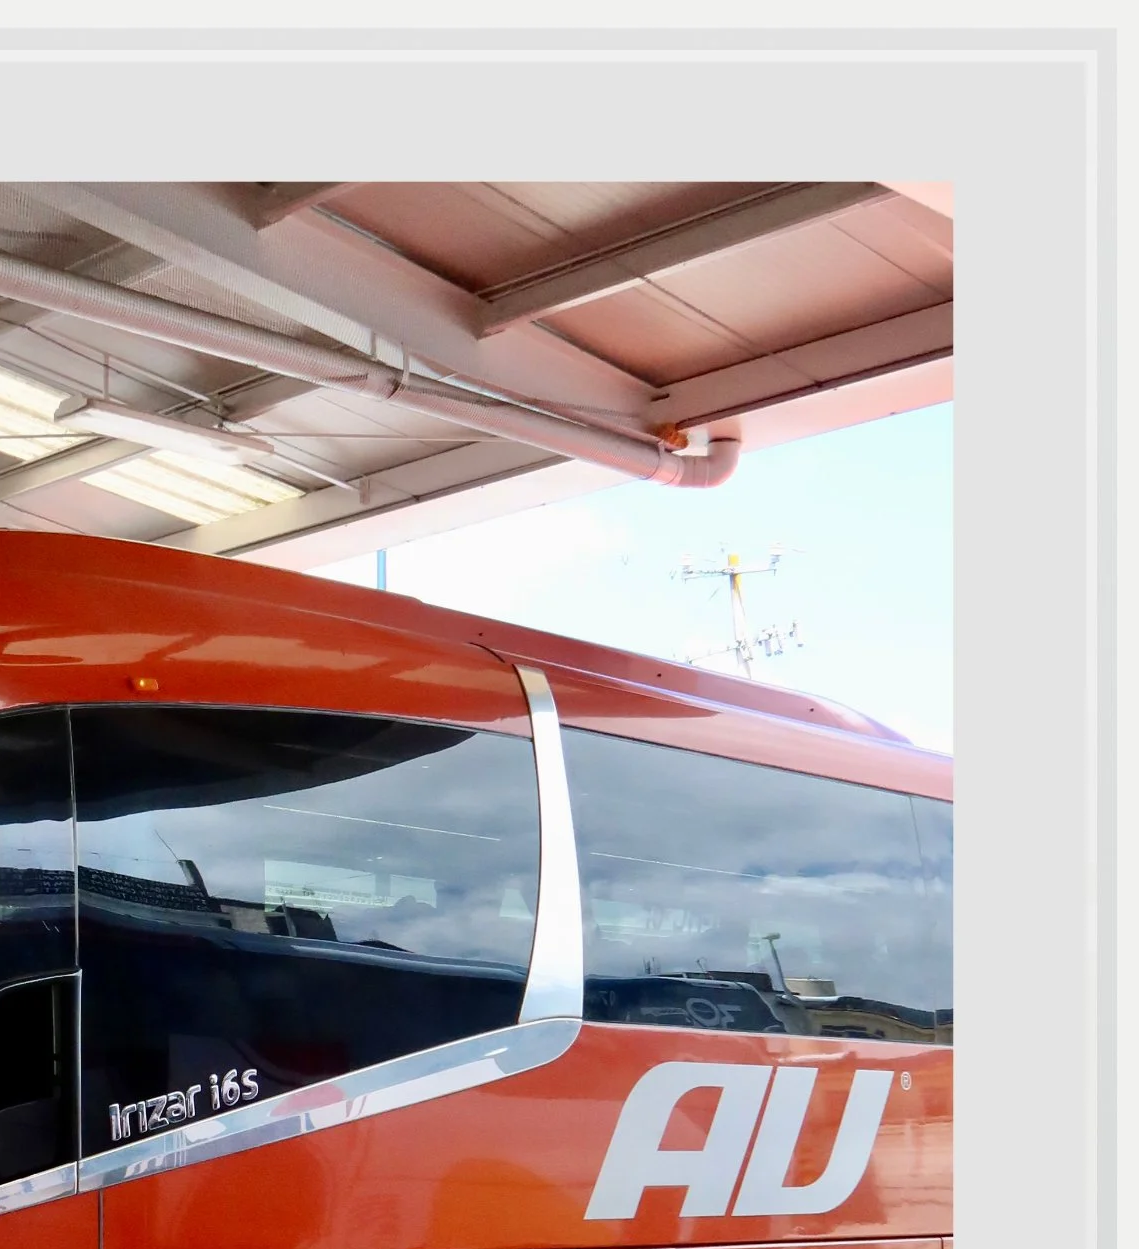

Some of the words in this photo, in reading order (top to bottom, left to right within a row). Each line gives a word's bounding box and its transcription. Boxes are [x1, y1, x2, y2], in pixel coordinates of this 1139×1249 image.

[109, 1084, 202, 1141] Irizar
[209, 1068, 259, 1110] i6s
[583, 1061, 895, 1221] AU
